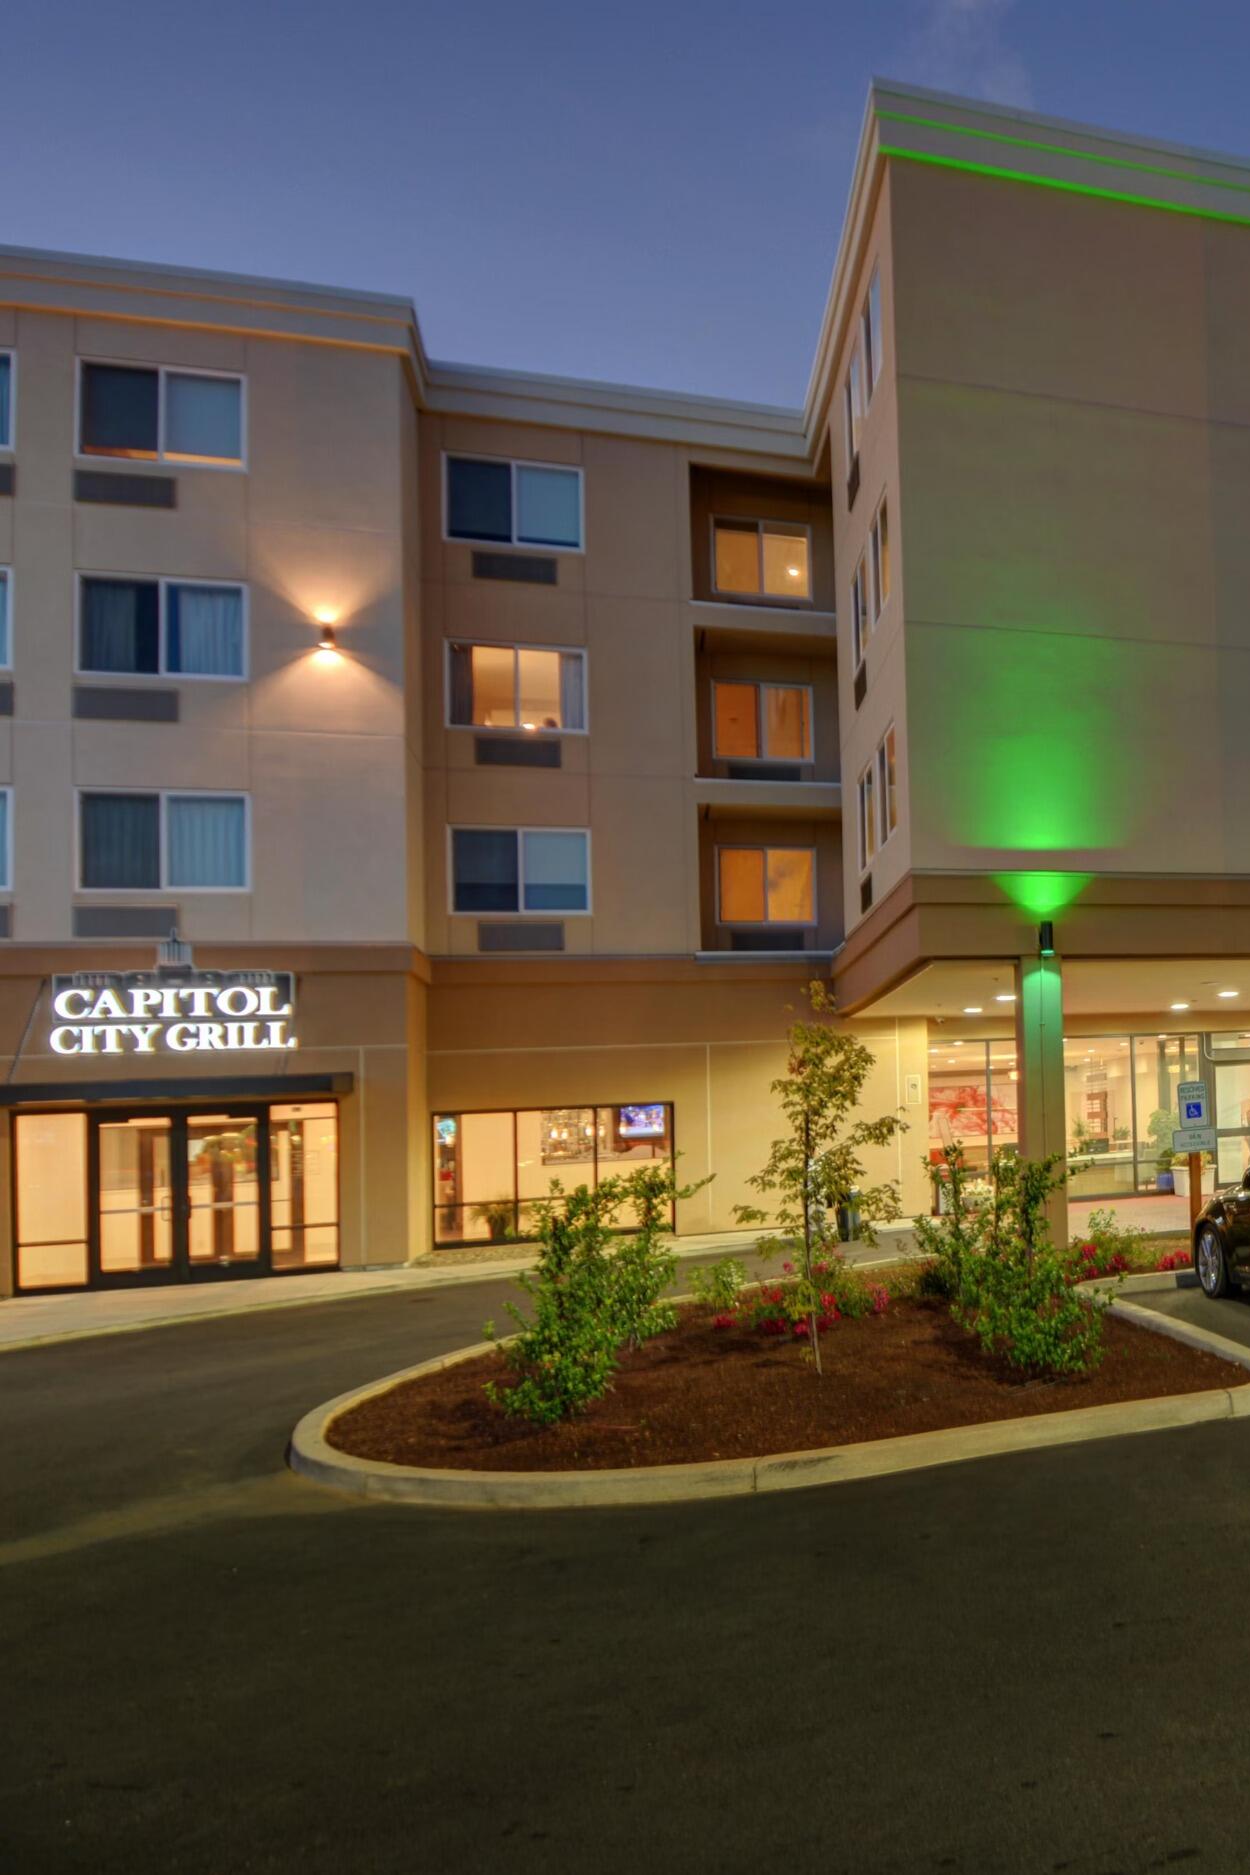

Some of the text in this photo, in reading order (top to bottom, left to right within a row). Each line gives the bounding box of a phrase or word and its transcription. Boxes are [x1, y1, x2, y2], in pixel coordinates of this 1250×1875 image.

[53, 986, 293, 1019] CAPITOL
[50, 1021, 299, 1055] CITY GRILL
